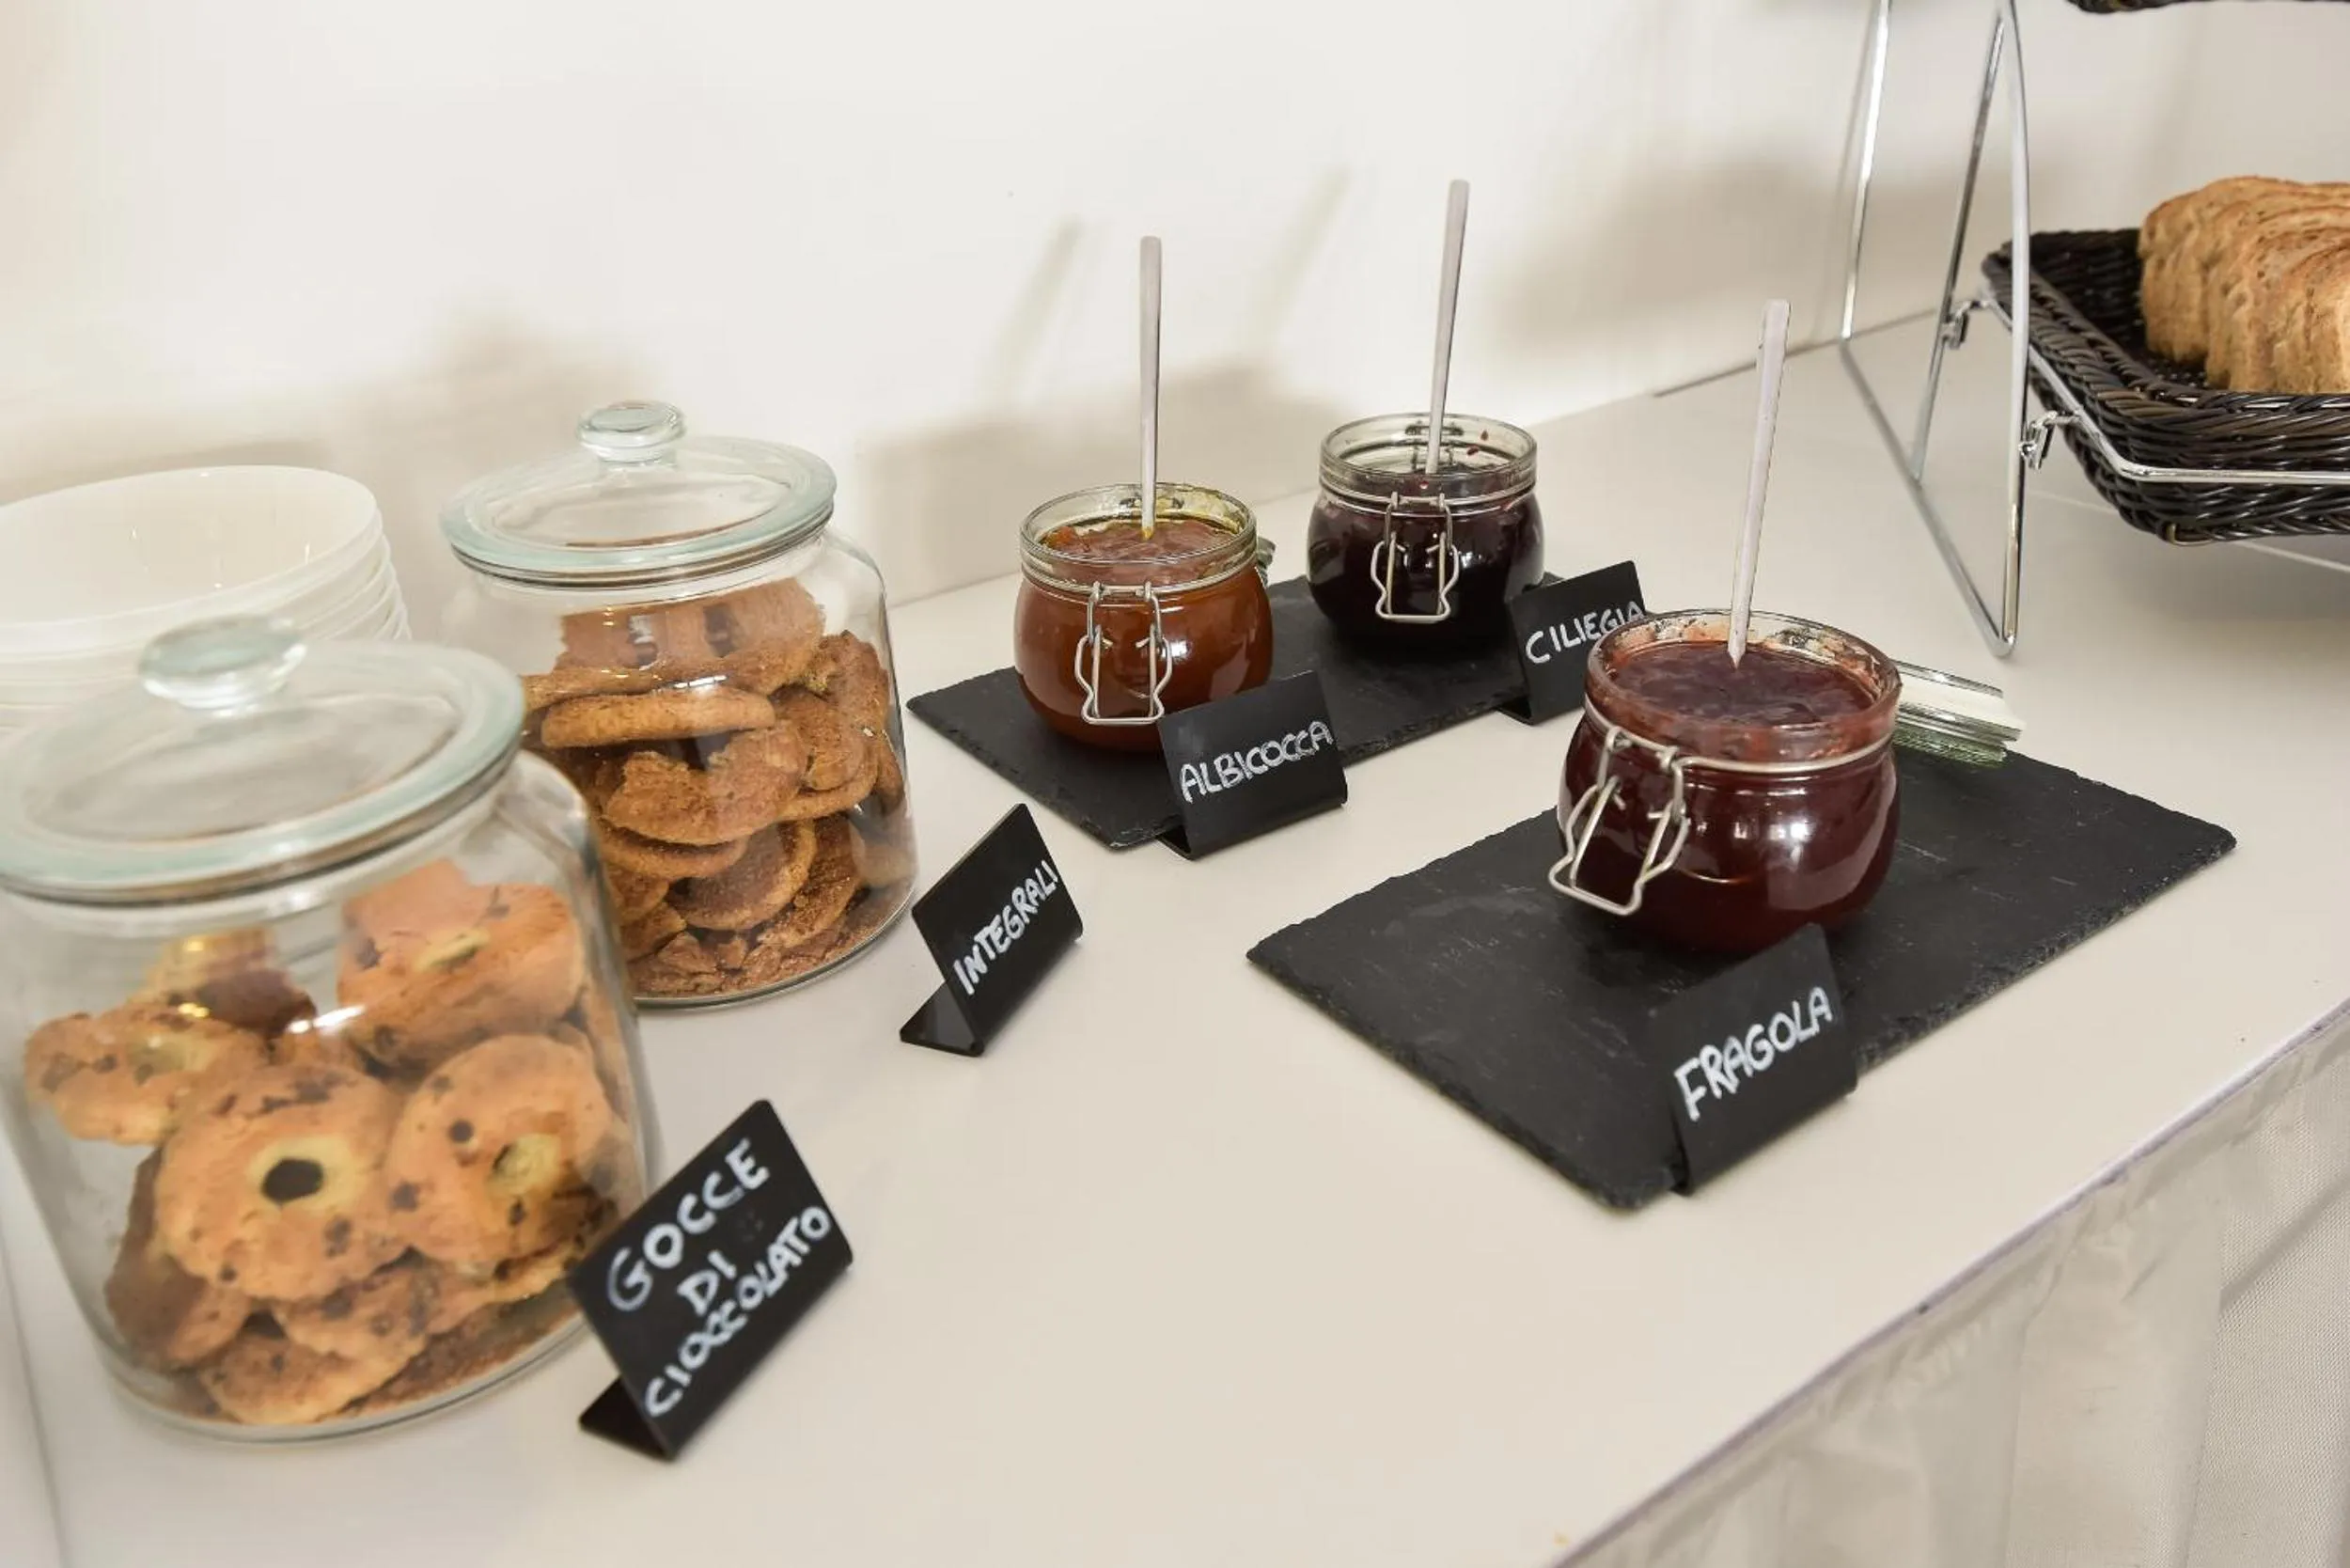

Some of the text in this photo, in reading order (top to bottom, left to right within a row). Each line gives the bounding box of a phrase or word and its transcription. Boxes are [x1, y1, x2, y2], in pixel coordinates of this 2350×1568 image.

[1525, 601, 1645, 664] CILIEGIA
[1180, 721, 1334, 804] ALBICOCCA
[953, 859, 1058, 996] INTEGRALI
[1673, 986, 1833, 1121] FRAGOLA
[606, 1137, 770, 1312] GOCCE
[676, 1249, 737, 1316] DI
